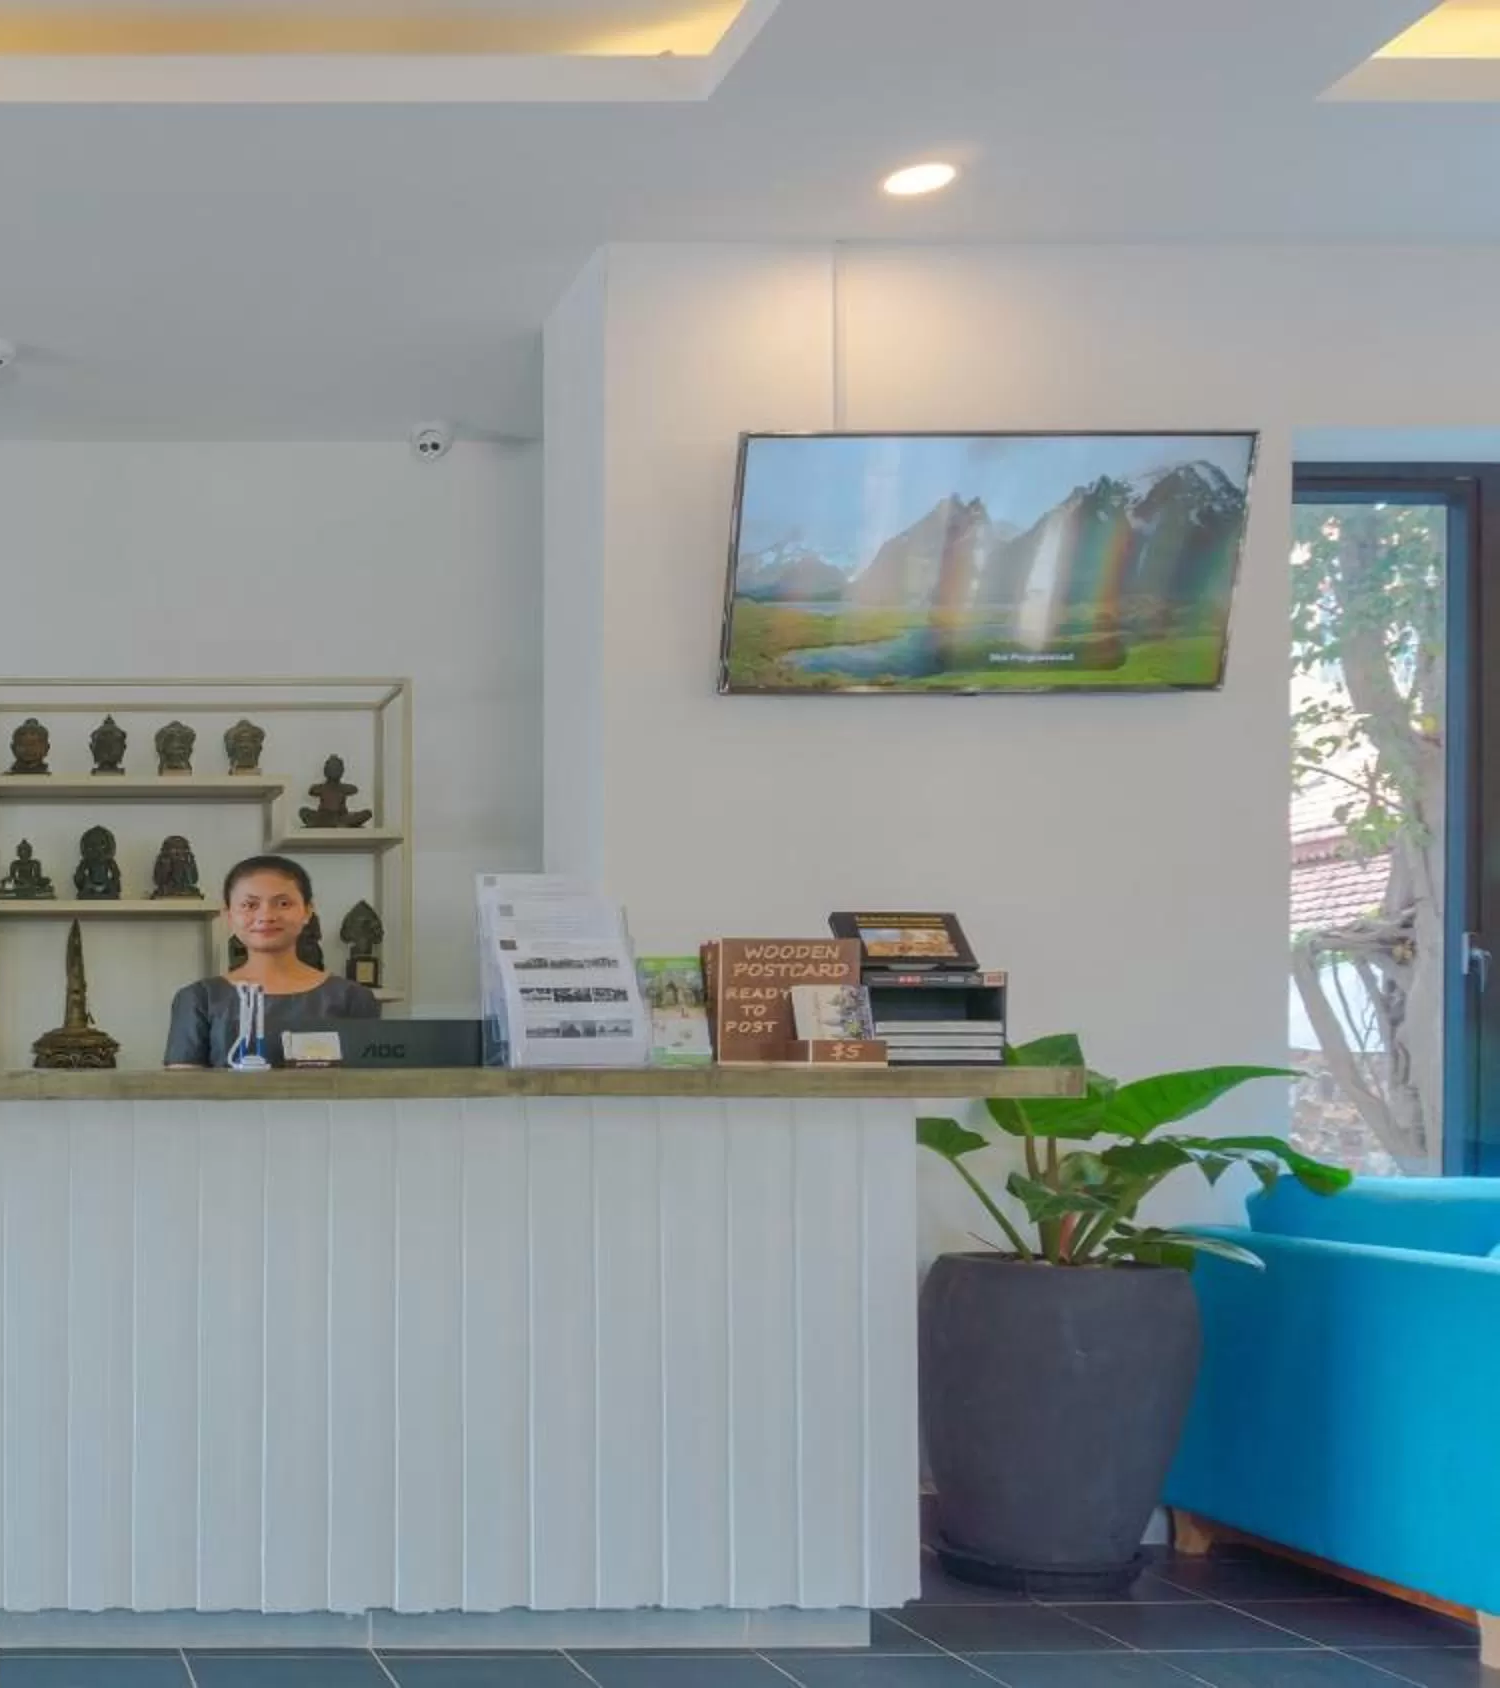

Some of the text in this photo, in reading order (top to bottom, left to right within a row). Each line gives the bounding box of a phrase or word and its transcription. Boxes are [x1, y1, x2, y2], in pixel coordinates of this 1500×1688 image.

[744, 944, 840, 960] WOODEN
[733, 963, 849, 978] POSTCARD
[725, 986, 792, 1002] READY
[740, 1004, 767, 1017] TO
[724, 1020, 778, 1033] POST
[361, 1043, 406, 1059] AOC
[830, 1043, 864, 1060] $5
